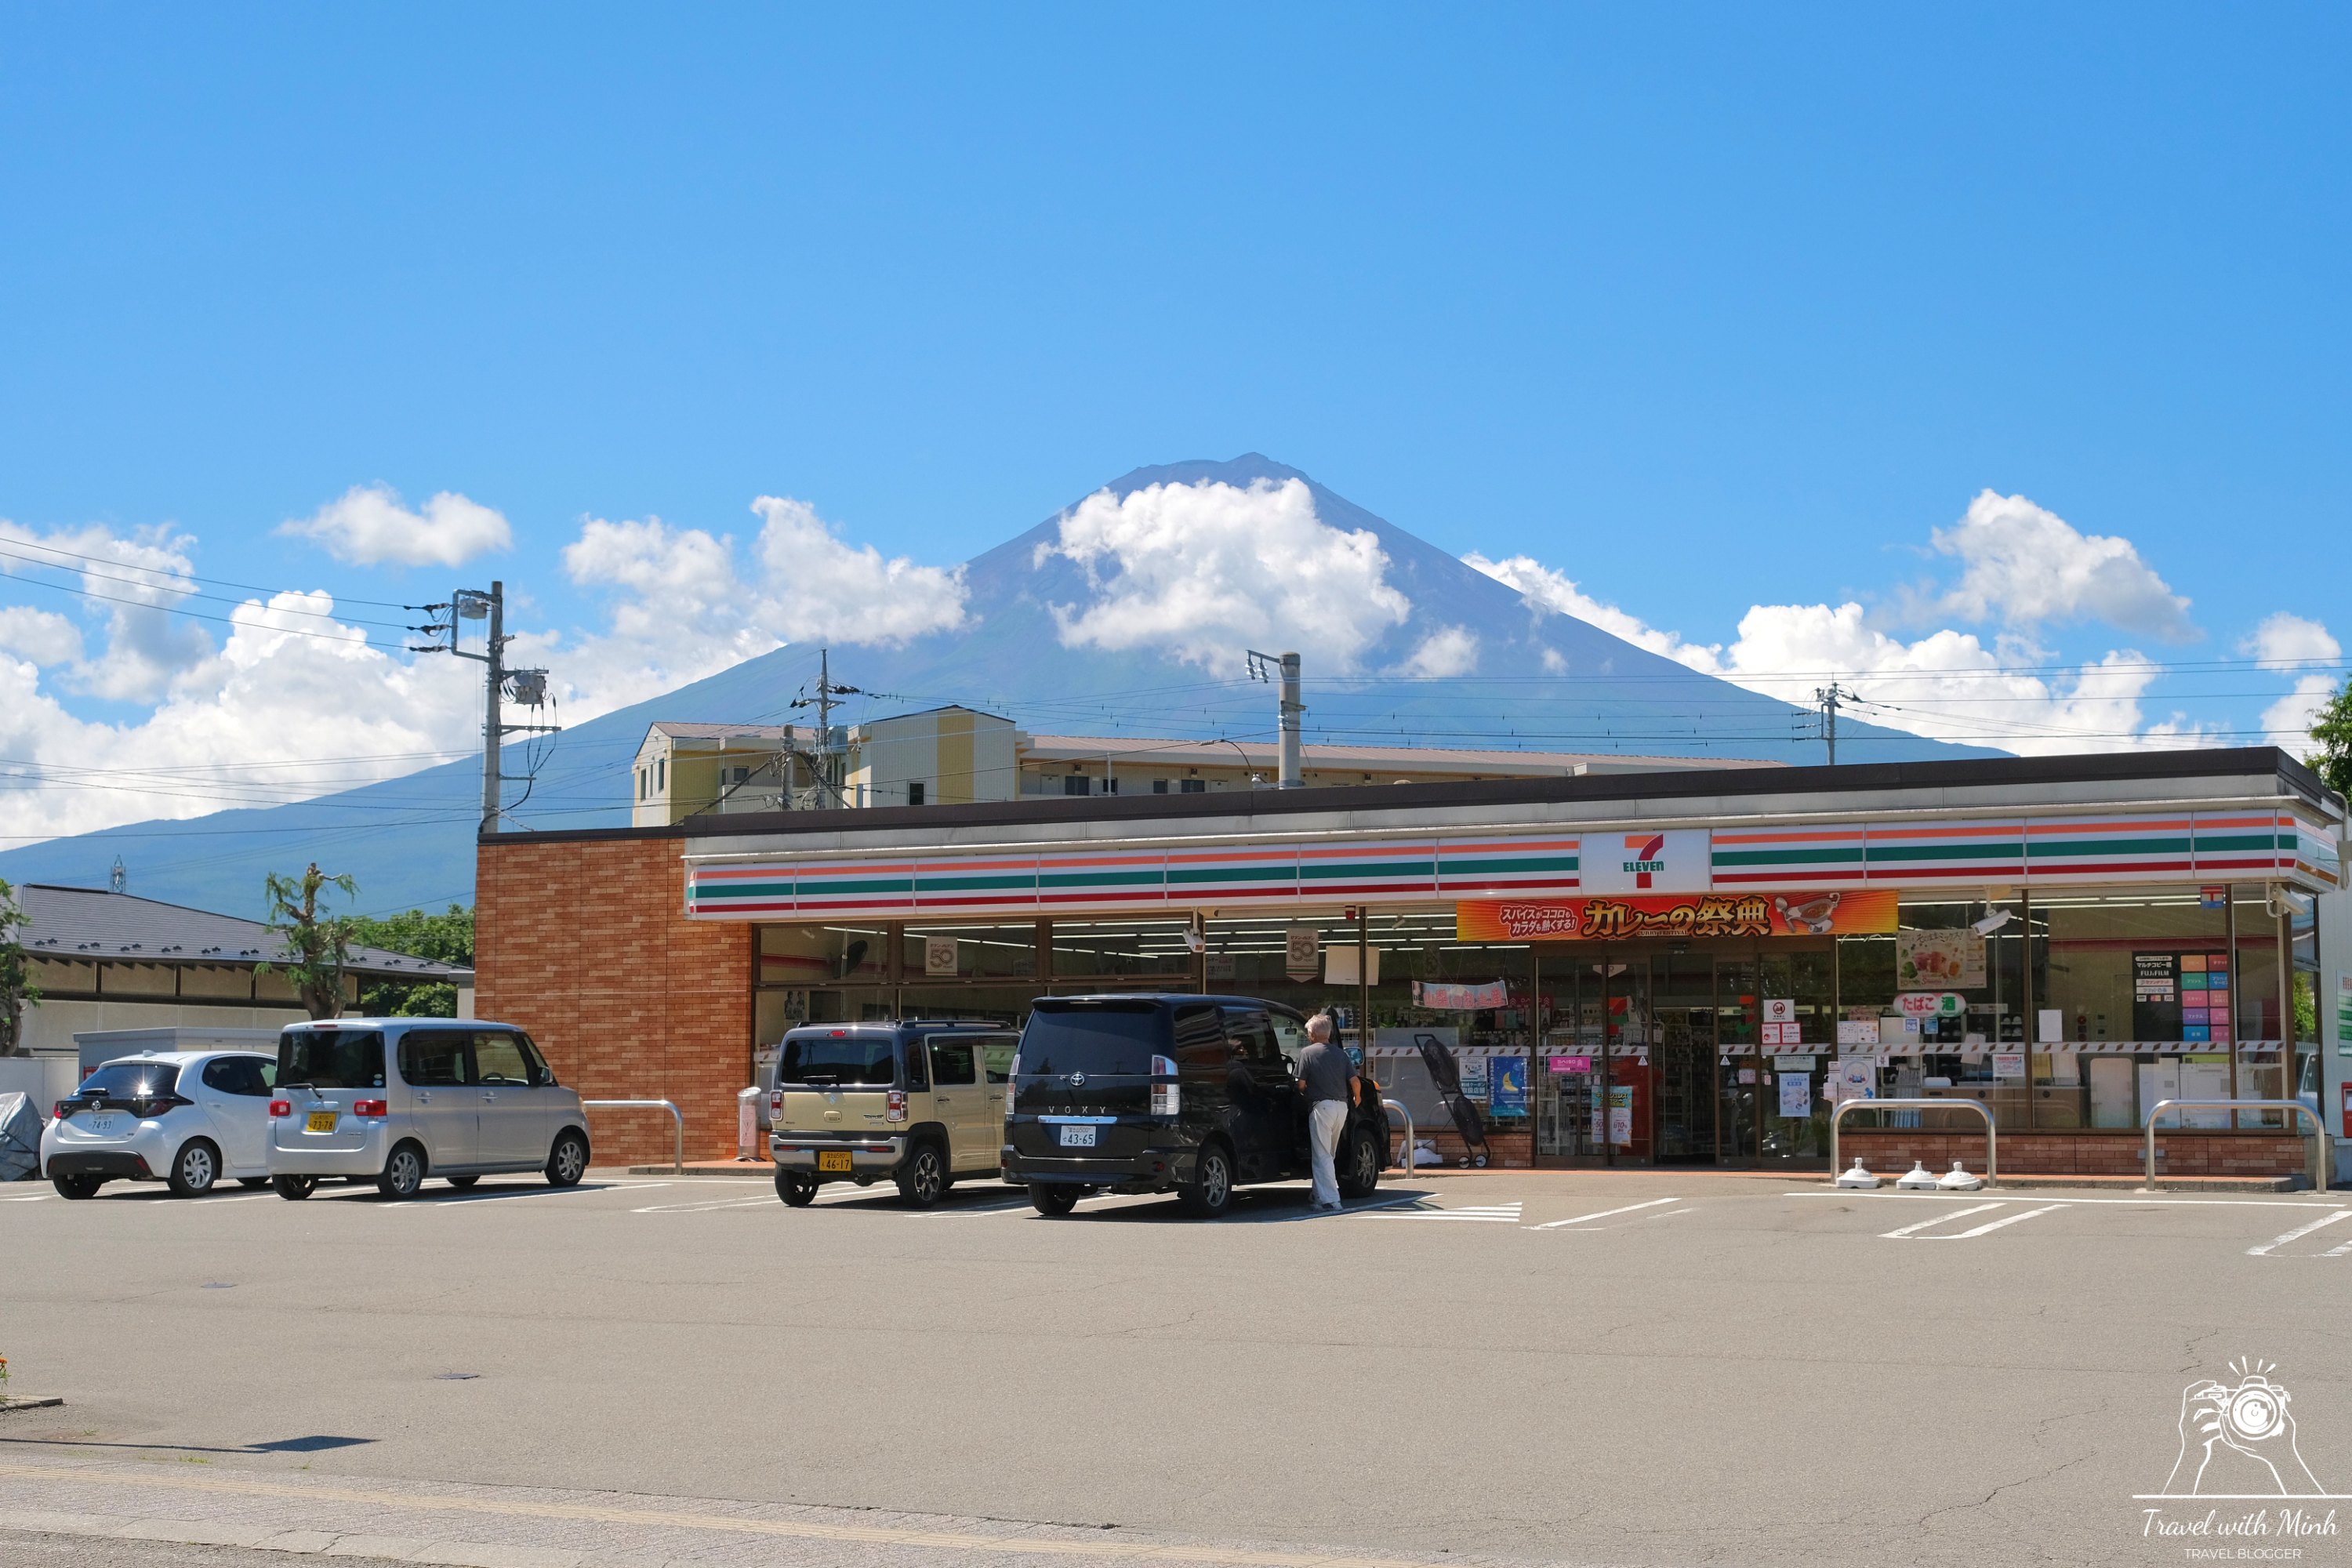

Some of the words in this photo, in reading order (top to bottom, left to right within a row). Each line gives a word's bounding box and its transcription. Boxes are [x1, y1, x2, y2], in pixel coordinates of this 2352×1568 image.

[1624, 834, 1664, 888] 7
[1503, 909, 1570, 920] スパイスがココロも
[1582, 898, 1770, 937] カレーの祭典
[1512, 919, 1574, 934] カラダも熱くする!
[930, 949, 954, 968] 50
[1290, 941, 1315, 961] 50
[1902, 996, 1935, 1011] たばこ
[1941, 996, 1956, 1011] 酒
[314, 1120, 332, 1130] 73-78
[1068, 1134, 1094, 1145] 43-65
[826, 1160, 850, 1169] 46-17
